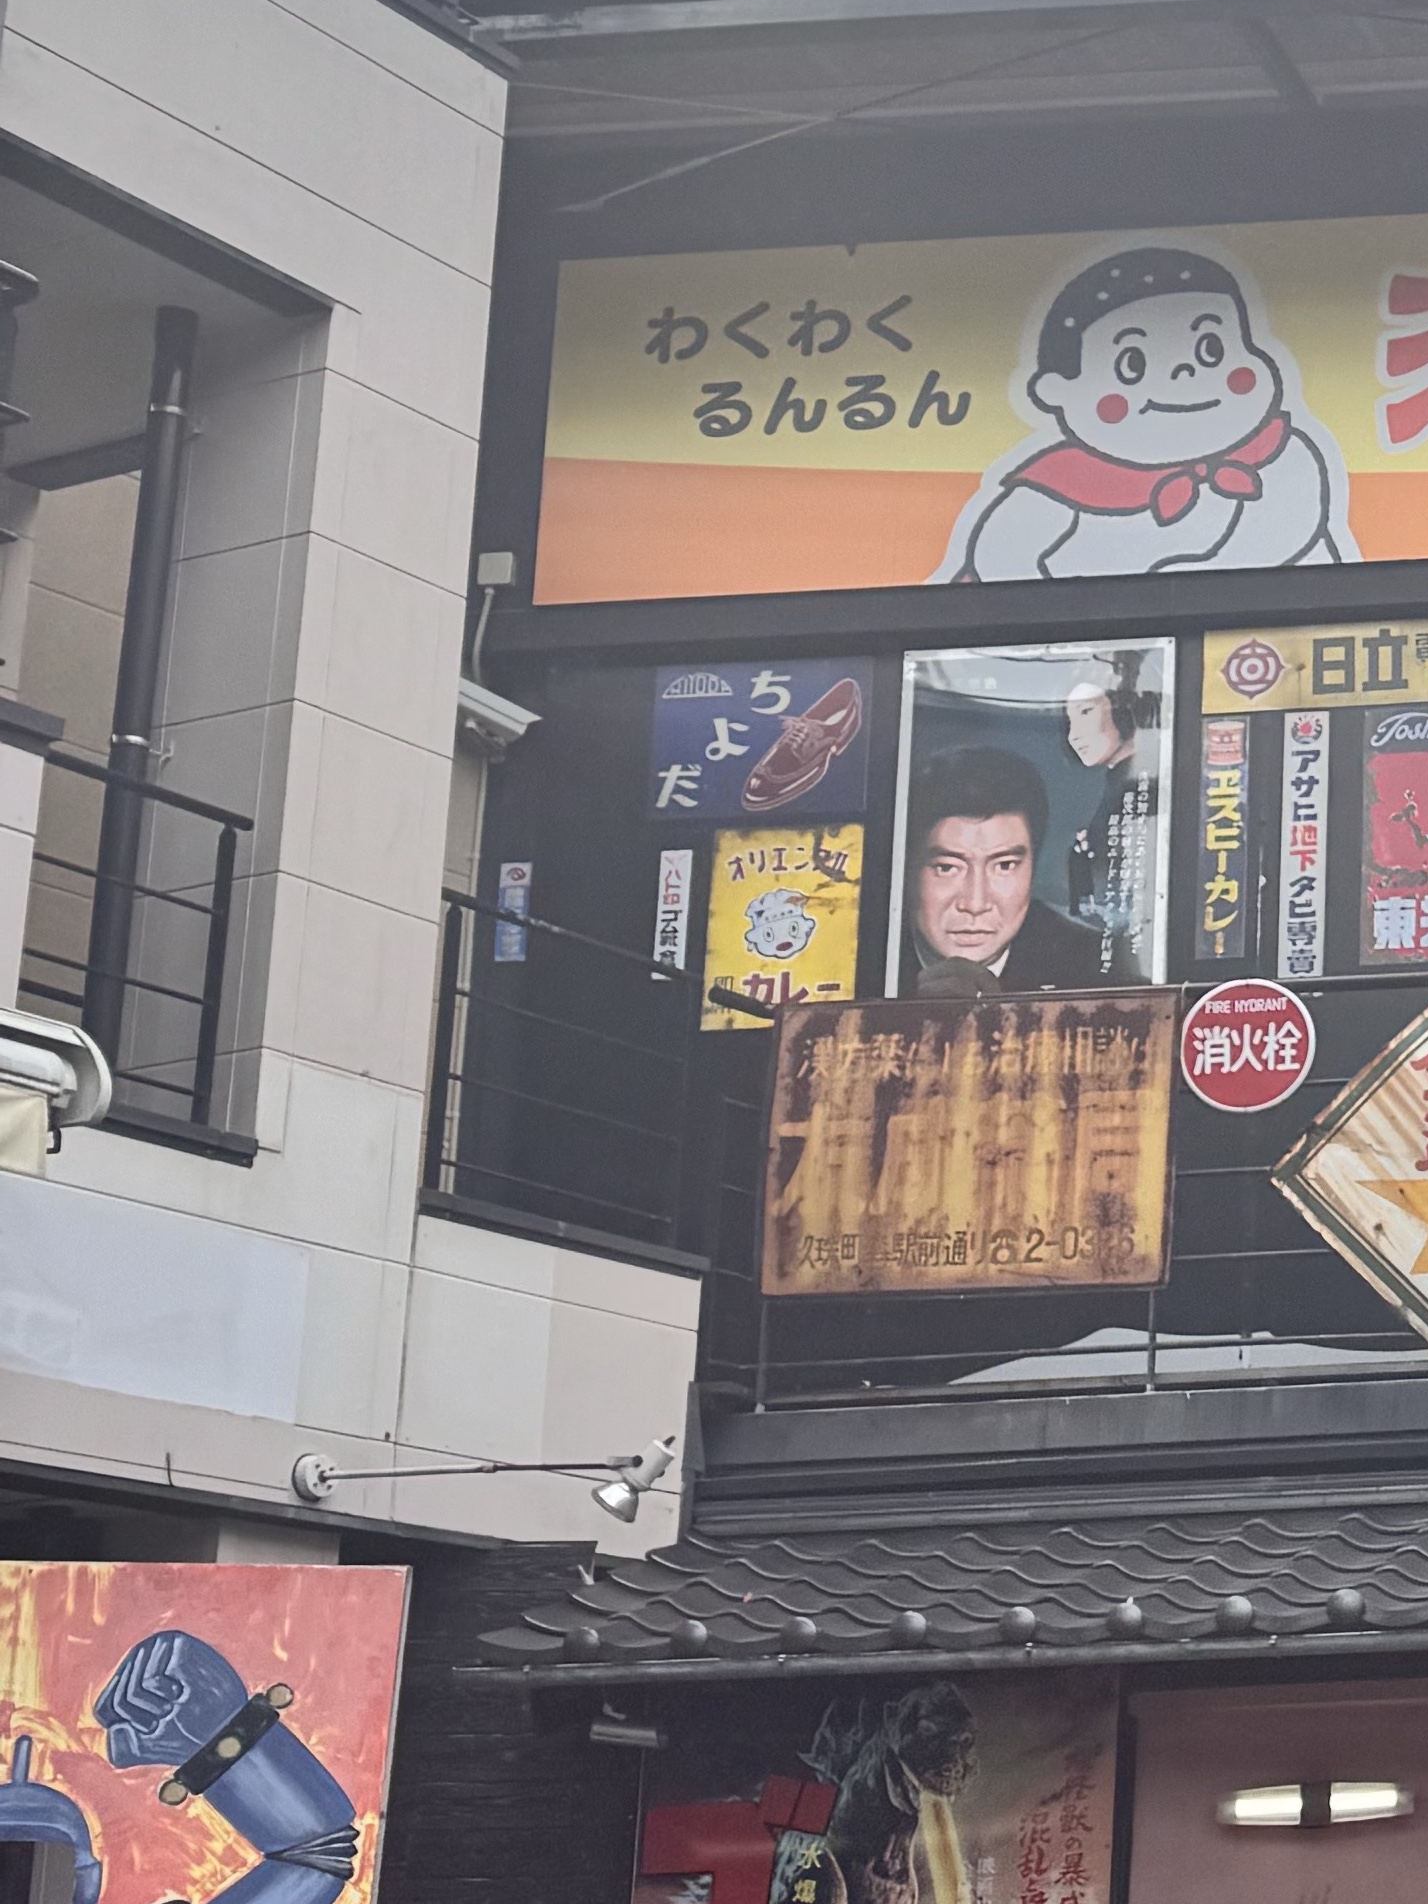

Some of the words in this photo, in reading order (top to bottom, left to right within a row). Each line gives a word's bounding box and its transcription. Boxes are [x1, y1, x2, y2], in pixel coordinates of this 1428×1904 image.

[646, 294, 918, 364] わくわく
[692, 369, 973, 440] るんるん
[656, 670, 791, 808] ちよだ
[742, 971, 840, 1004] カレー
[1205, 1000, 1231, 1014] FIRE
[1235, 997, 1288, 1013] HYDRANT
[1192, 1020, 1302, 1076] 消火栓
